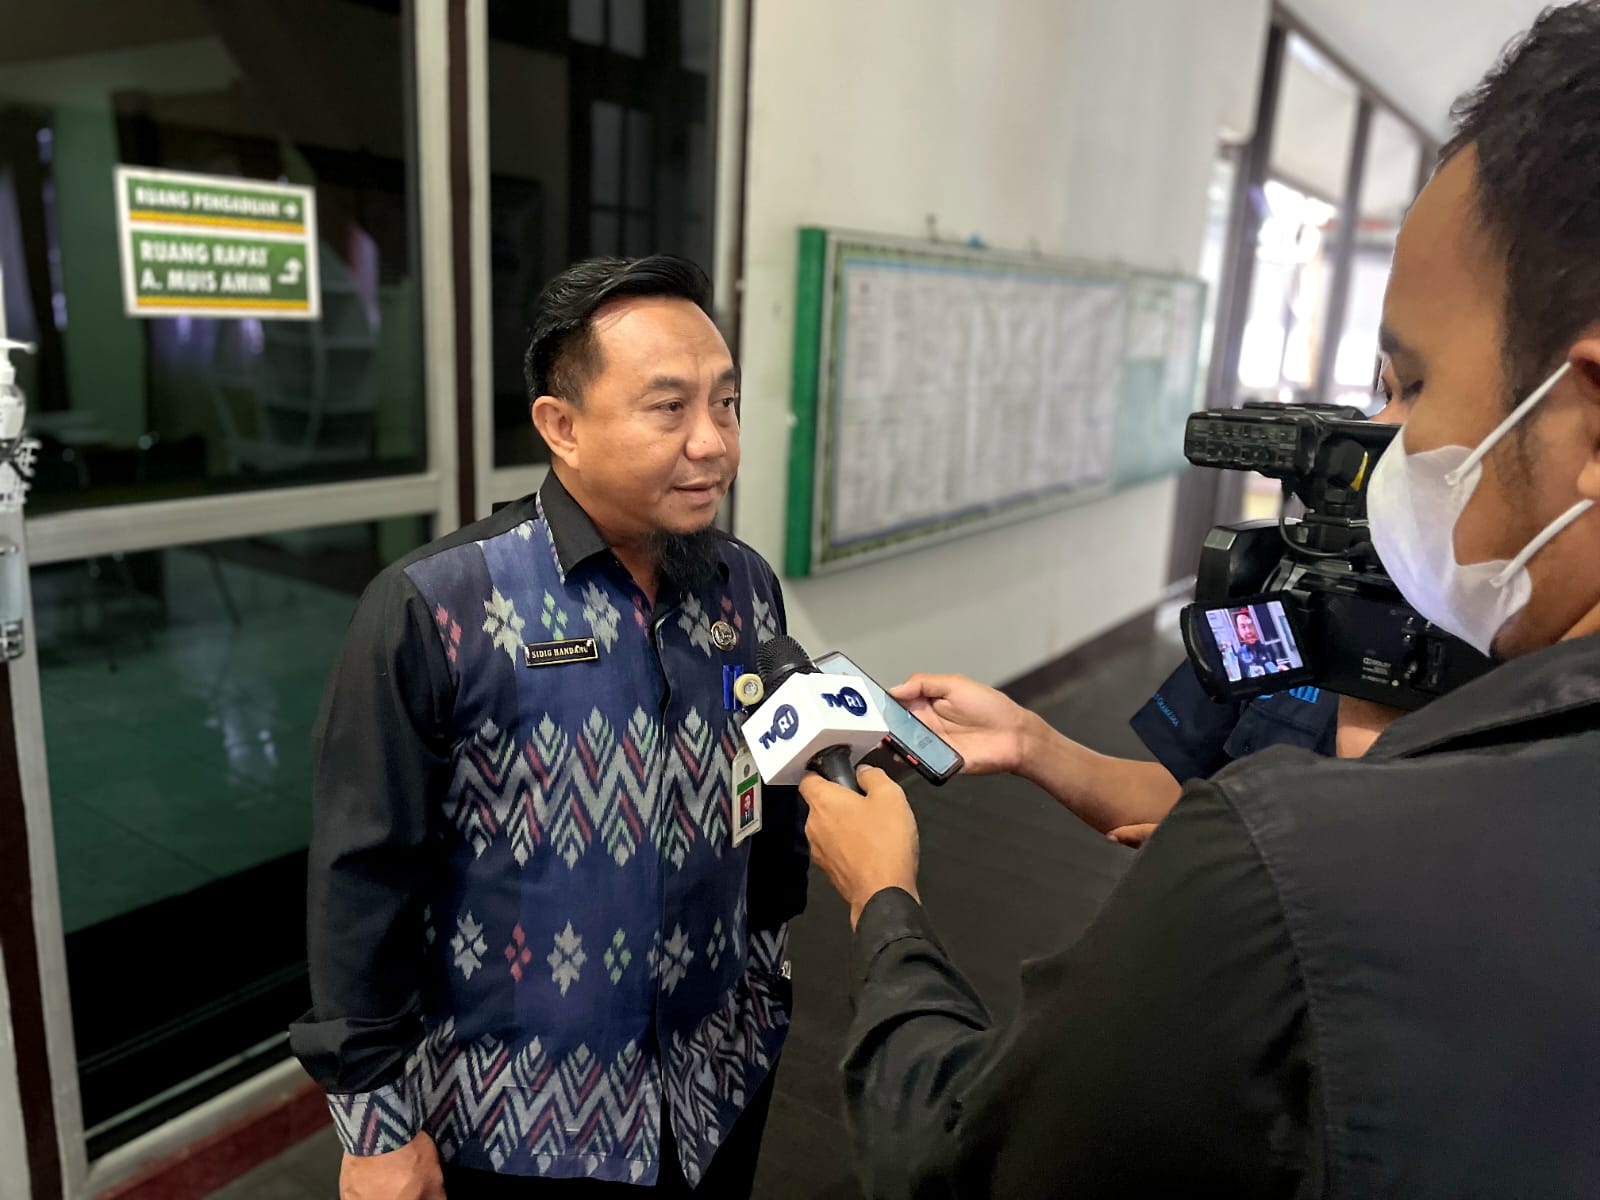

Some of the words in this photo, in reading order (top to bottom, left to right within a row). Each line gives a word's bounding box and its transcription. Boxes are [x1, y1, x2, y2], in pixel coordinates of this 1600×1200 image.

[135, 187, 189, 208] RUANG
[140, 240, 209, 264] RUANG
[212, 244, 268, 267] RAPAT
[140, 267, 163, 290] A.
[166, 269, 217, 292] MUIS
[220, 272, 272, 294] AMIN
[821, 686, 867, 716] TVRI
[758, 704, 799, 750] TVRI
